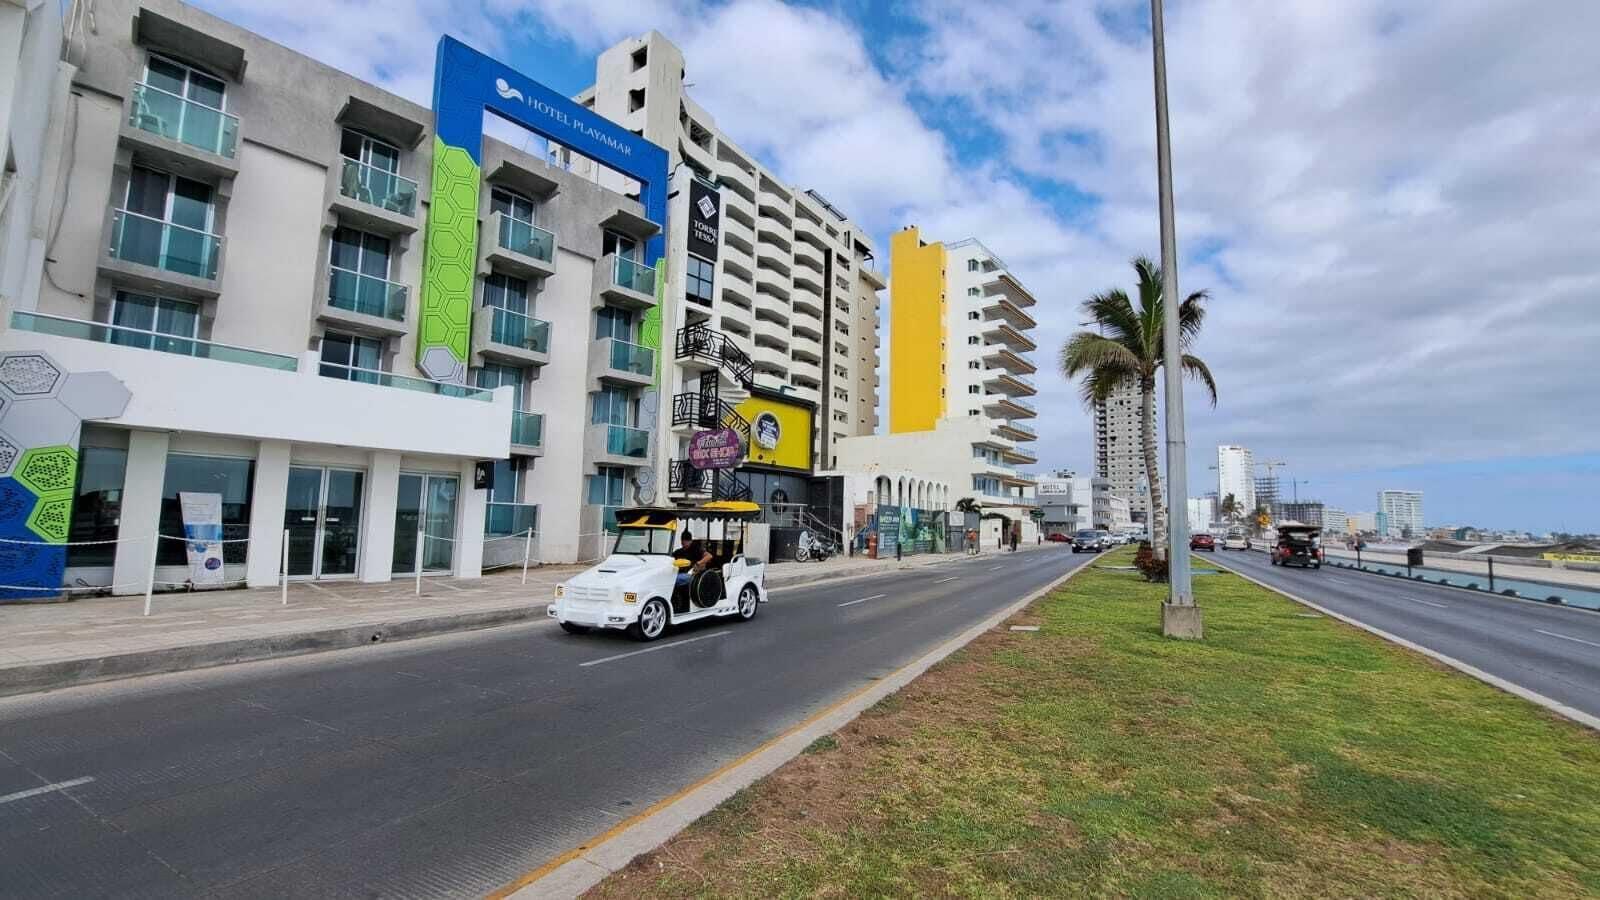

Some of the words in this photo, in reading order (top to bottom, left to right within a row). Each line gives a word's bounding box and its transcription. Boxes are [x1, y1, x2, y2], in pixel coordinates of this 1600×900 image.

[528, 95, 571, 127] HOTEL
[573, 119, 632, 156] PLAYAMAR
[694, 219, 718, 239] TORRE
[694, 229, 717, 246] TESSA
